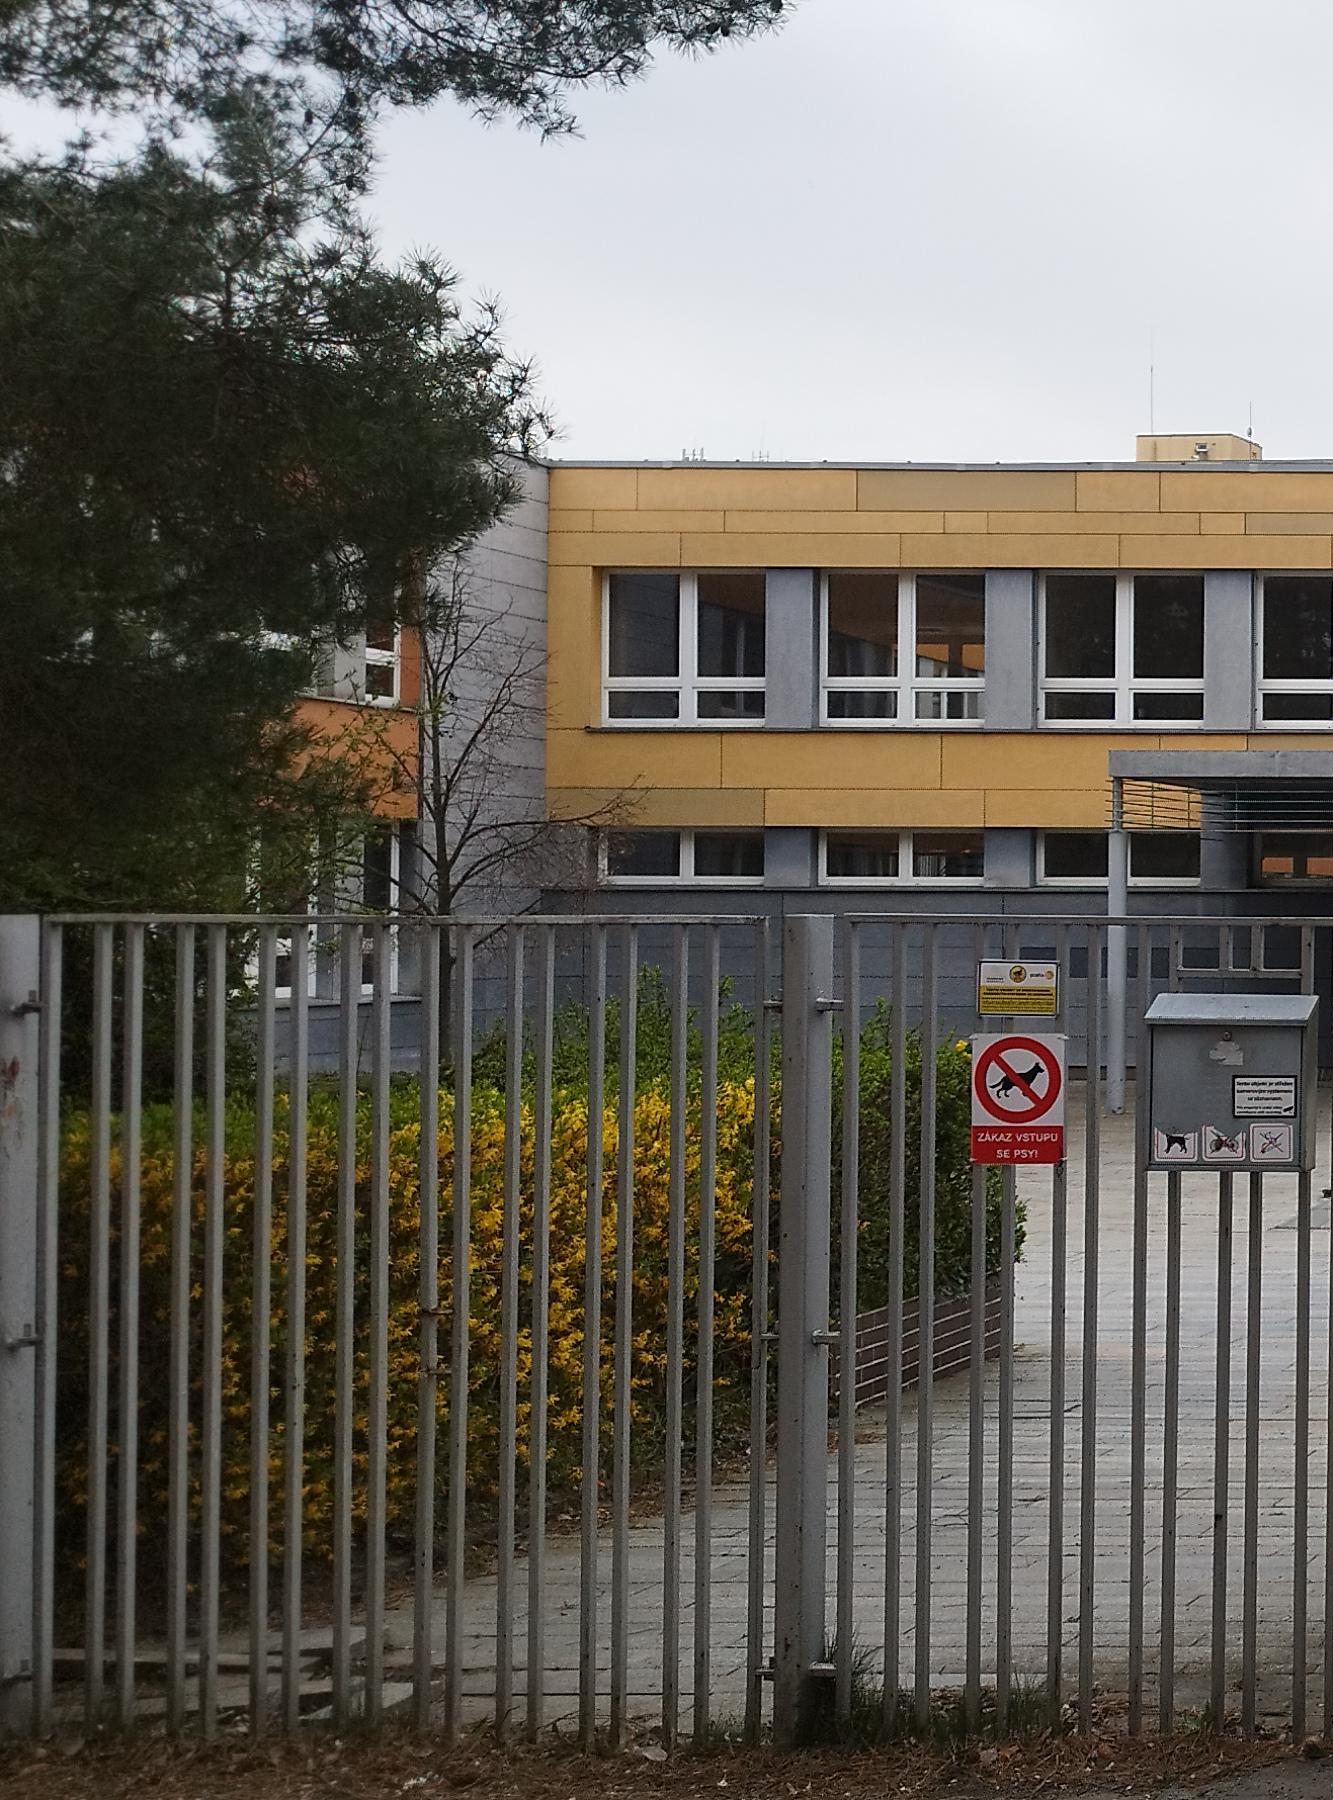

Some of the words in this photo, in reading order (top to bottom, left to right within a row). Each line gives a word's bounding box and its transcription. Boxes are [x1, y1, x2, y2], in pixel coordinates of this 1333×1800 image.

[977, 1131, 1012, 1142] ZÁKAZ
[1015, 1132, 1058, 1142] VSTUPU
[996, 1149, 1010, 1158] SE
[1014, 1149, 1038, 1158] PSY!
